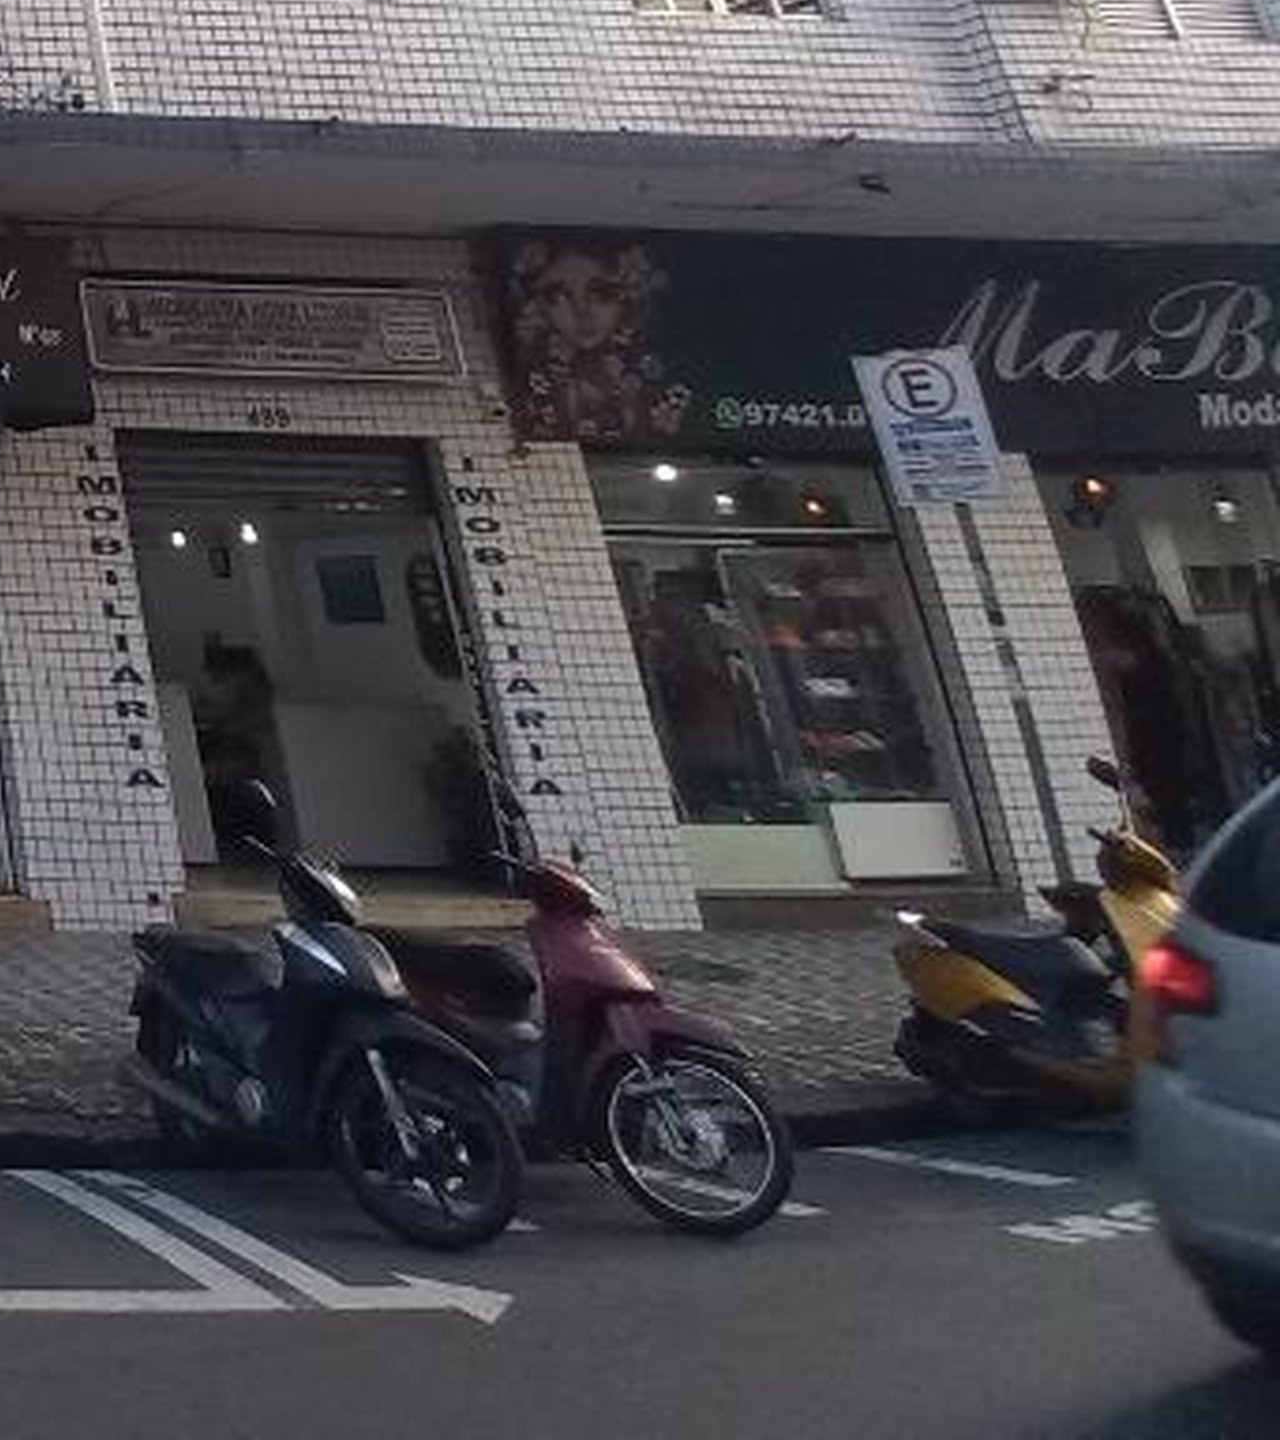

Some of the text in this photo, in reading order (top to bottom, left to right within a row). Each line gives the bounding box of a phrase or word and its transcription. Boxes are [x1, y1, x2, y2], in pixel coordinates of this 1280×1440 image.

[940, 278, 1280, 383] MaB
[898, 368, 939, 409] E
[1198, 392, 1280, 429] Mod
